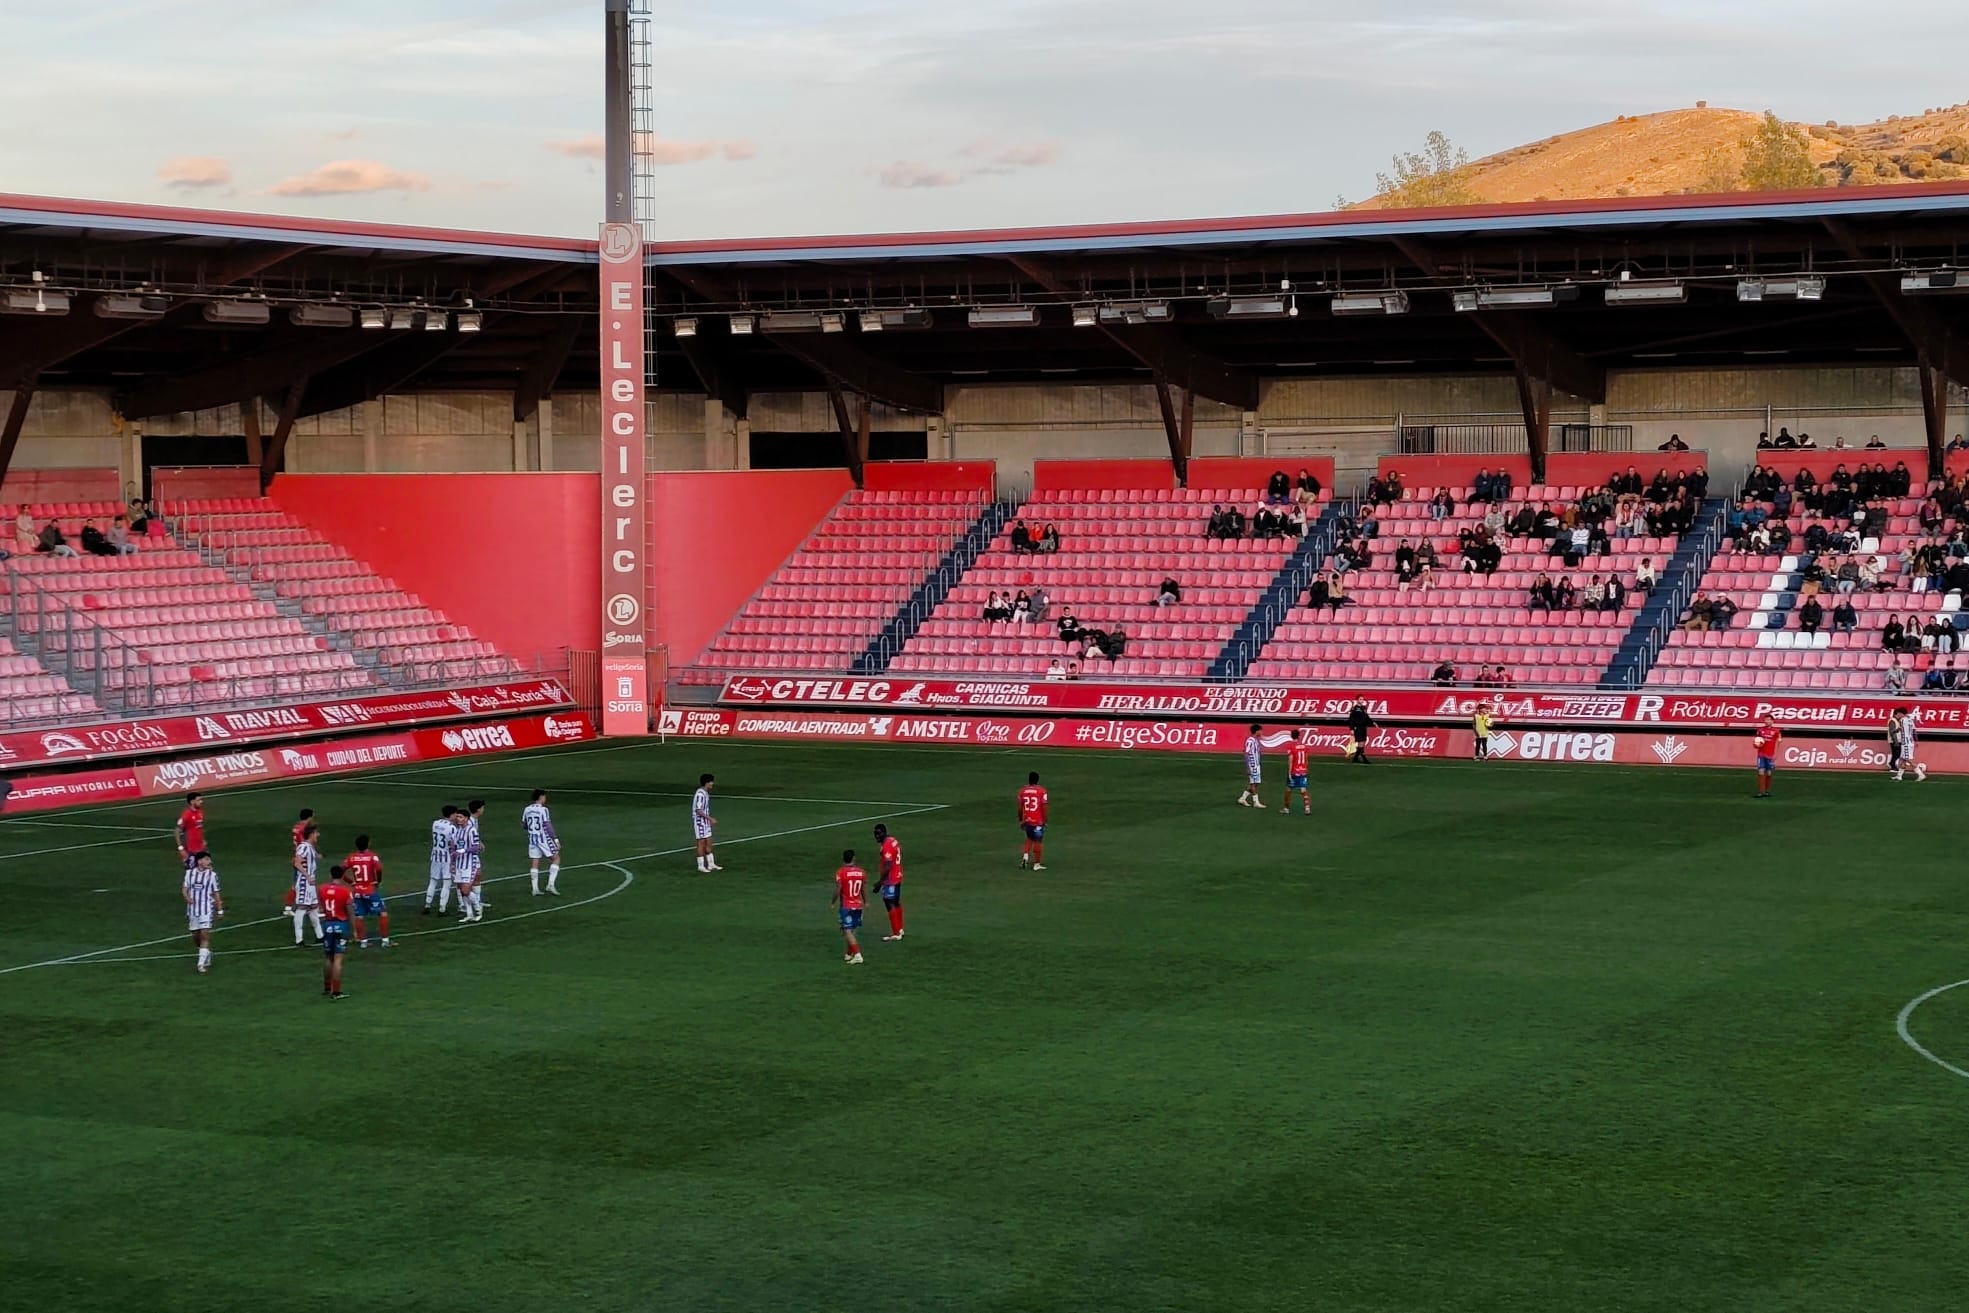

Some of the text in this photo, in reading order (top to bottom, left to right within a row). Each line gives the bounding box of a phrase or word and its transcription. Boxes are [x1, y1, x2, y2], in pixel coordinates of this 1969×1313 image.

[771, 680, 890, 701] CTELEC
[955, 683, 1030, 694] CARNICAS
[471, 690, 545, 708] Caja Soria
[608, 700, 643, 713] Soria
[969, 693, 1048, 706] GIAQUINTA
[1286, 699, 1320, 713] DE
[1323, 699, 1389, 714] SOIA
[687, 711, 720, 725] Grupo
[1564, 703, 1621, 716] BEEP
[1671, 700, 1749, 719] Rótulos
[1753, 703, 1847, 721] Pascual
[1851, 707, 1961, 721] BALRTE
[86, 722, 168, 746] FOGÓN
[683, 721, 730, 735] Herce
[737, 719, 866, 735] COMPRALAENTRADA
[896, 720, 969, 739] AMSTEL
[976, 720, 1010, 737] Oro
[1075, 720, 1217, 749] #eligeSoria
[462, 725, 515, 751] errea
[1300, 727, 1368, 754] Torrez
[1371, 728, 1391, 748] de
[1390, 729, 1436, 749] Soria
[1519, 732, 1616, 761] errea
[358, 748, 374, 763] DEL
[375, 744, 407, 761] DEPORTE
[1784, 746, 1828, 767] Caja
[1860, 749, 1892, 765] Sor
[159, 751, 265, 780] MONTE PINOS
[7, 778, 138, 800] CUPRA UNTORIA CAR
[1023, 797, 1038, 812] 23
[527, 816, 541, 832] 23
[352, 864, 369, 882] 21
[848, 879, 863, 898] 10
[324, 899, 336, 918] 4
